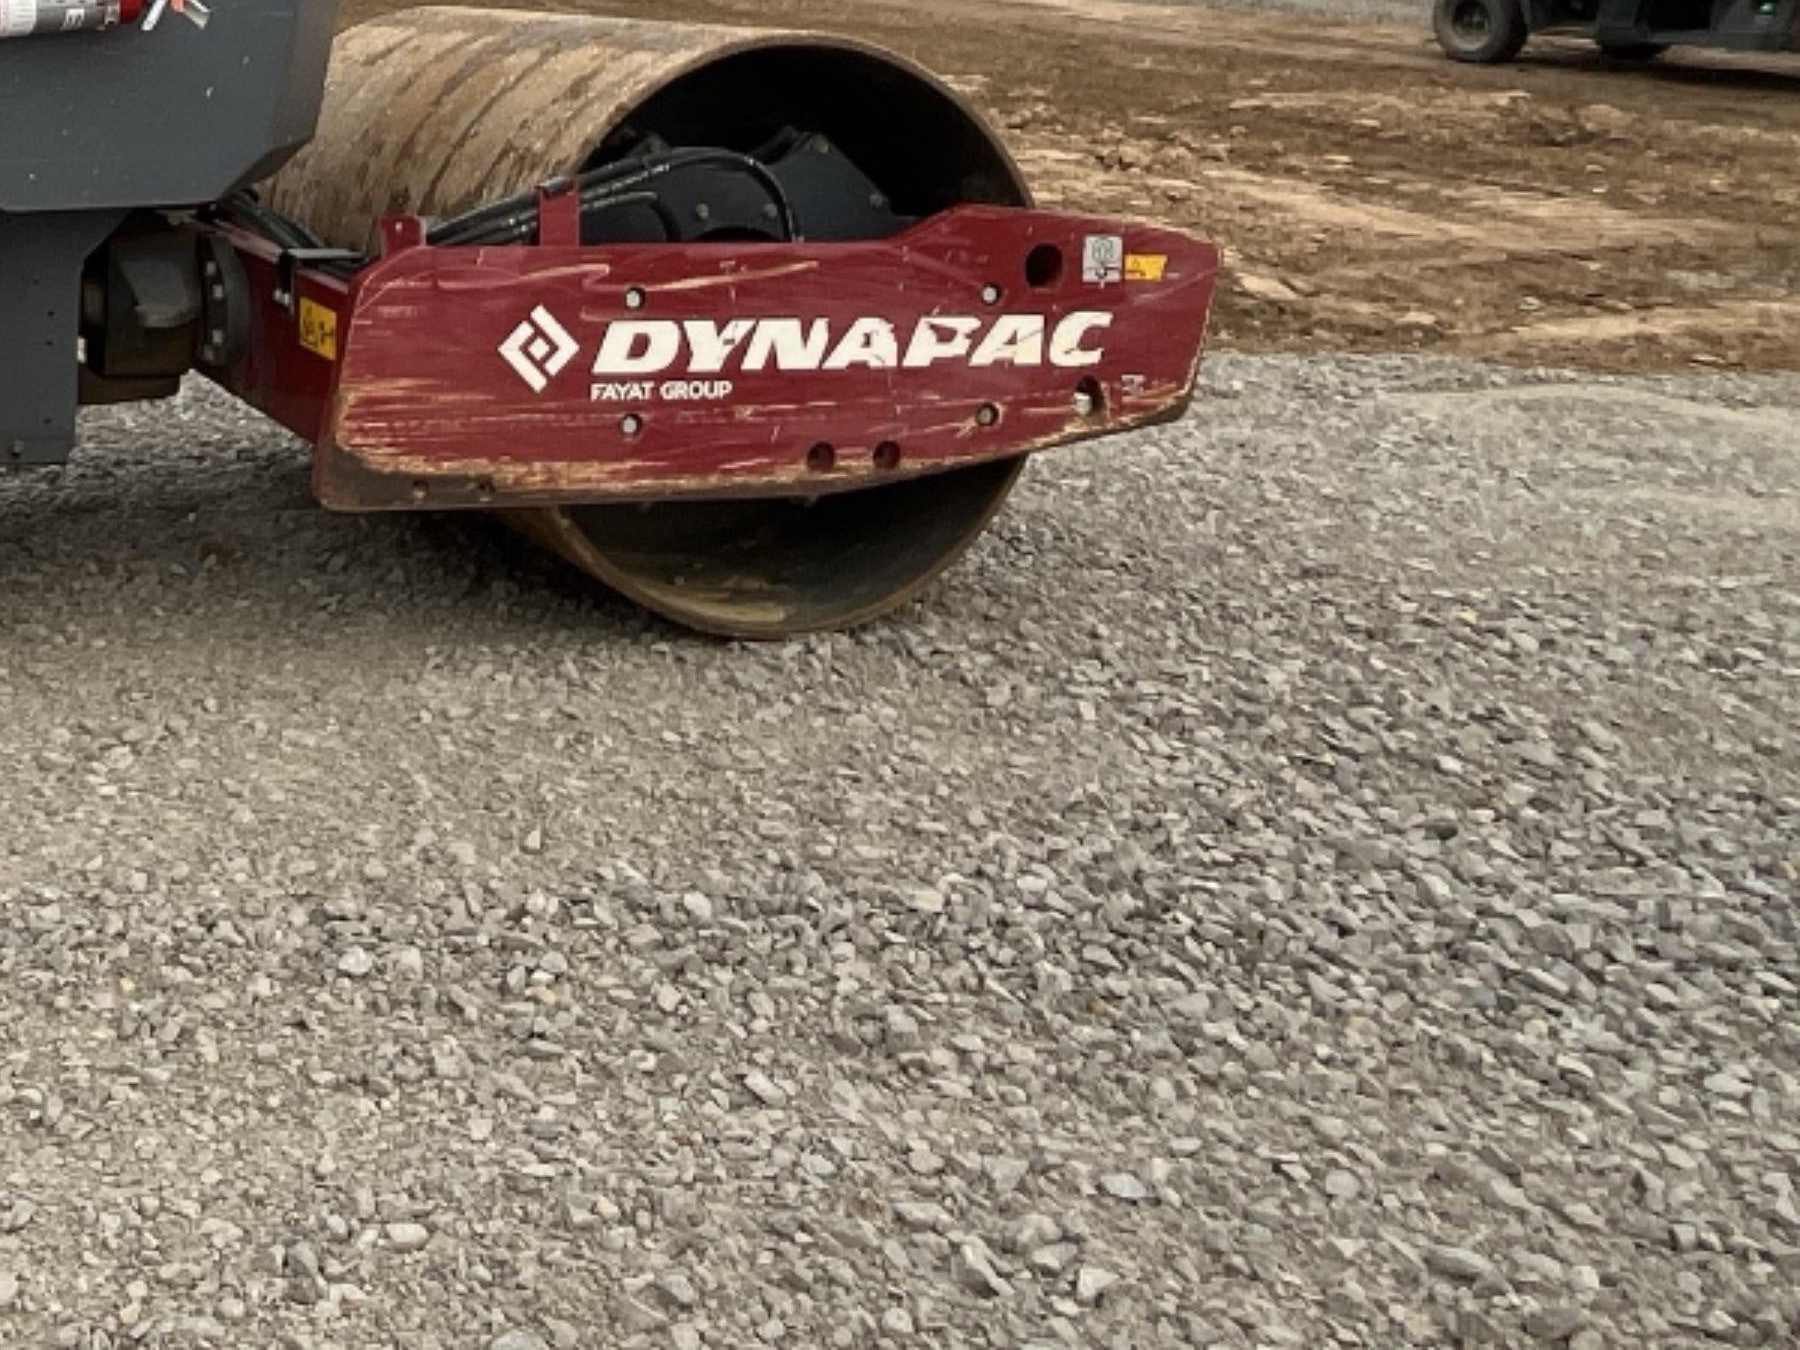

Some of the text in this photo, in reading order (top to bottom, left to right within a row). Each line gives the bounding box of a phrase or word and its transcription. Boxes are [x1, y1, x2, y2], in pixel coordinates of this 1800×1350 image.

[591, 310, 1114, 375] DYNAPAC
[589, 379, 734, 402] FAYAT GROUP
